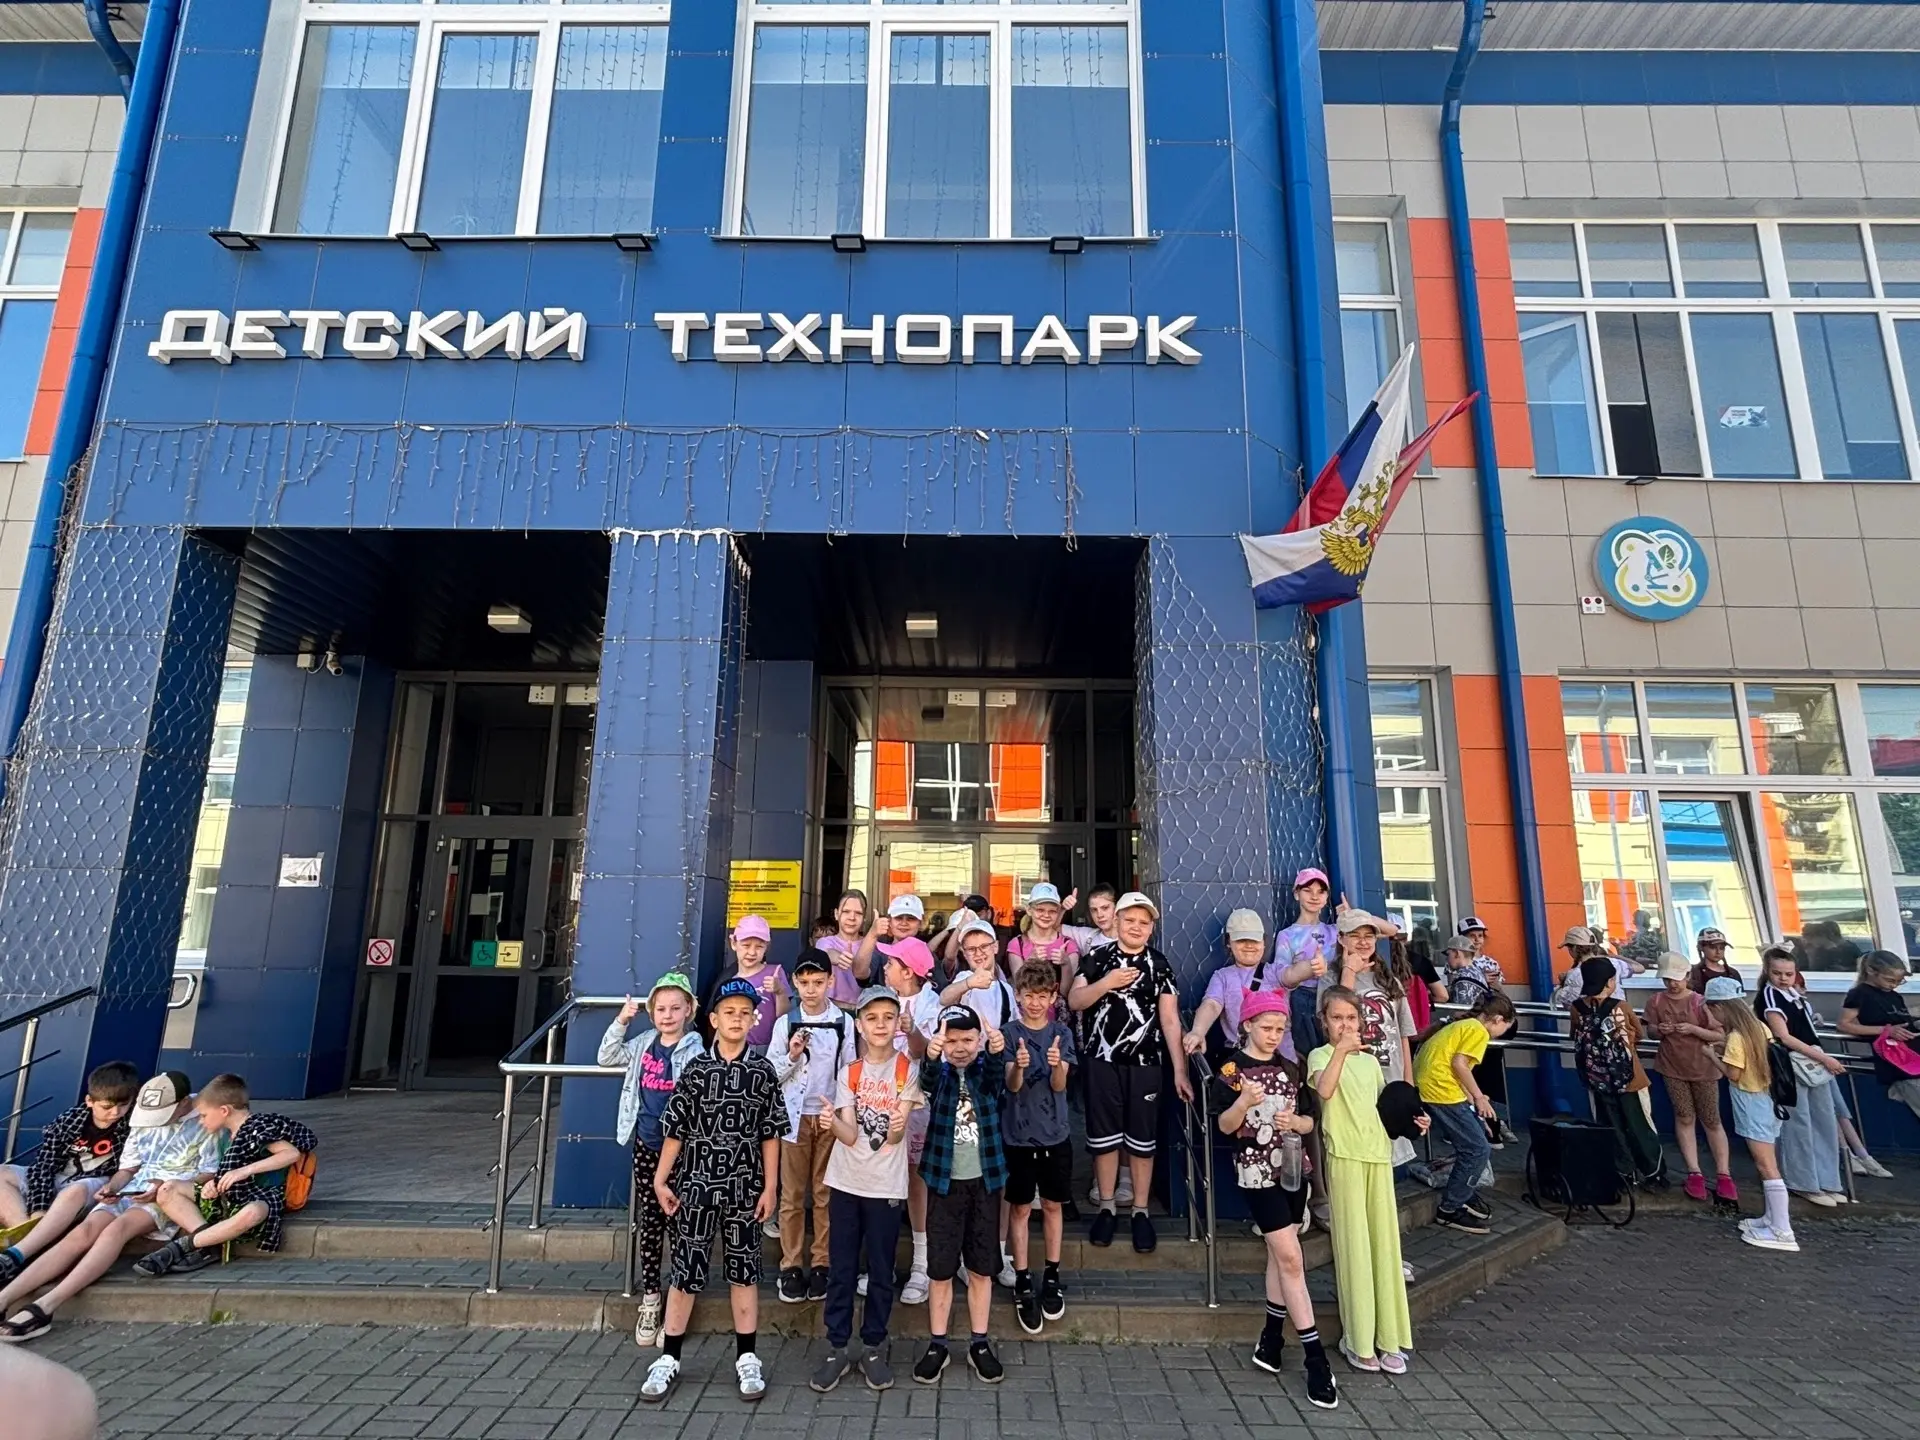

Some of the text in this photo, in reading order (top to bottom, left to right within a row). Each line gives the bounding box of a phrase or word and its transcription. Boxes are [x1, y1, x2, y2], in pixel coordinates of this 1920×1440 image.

[148, 307, 1203, 366] ДЕТСКИЙ ТЕХНОПАРК
[857, 1077, 875, 1093] EEP
